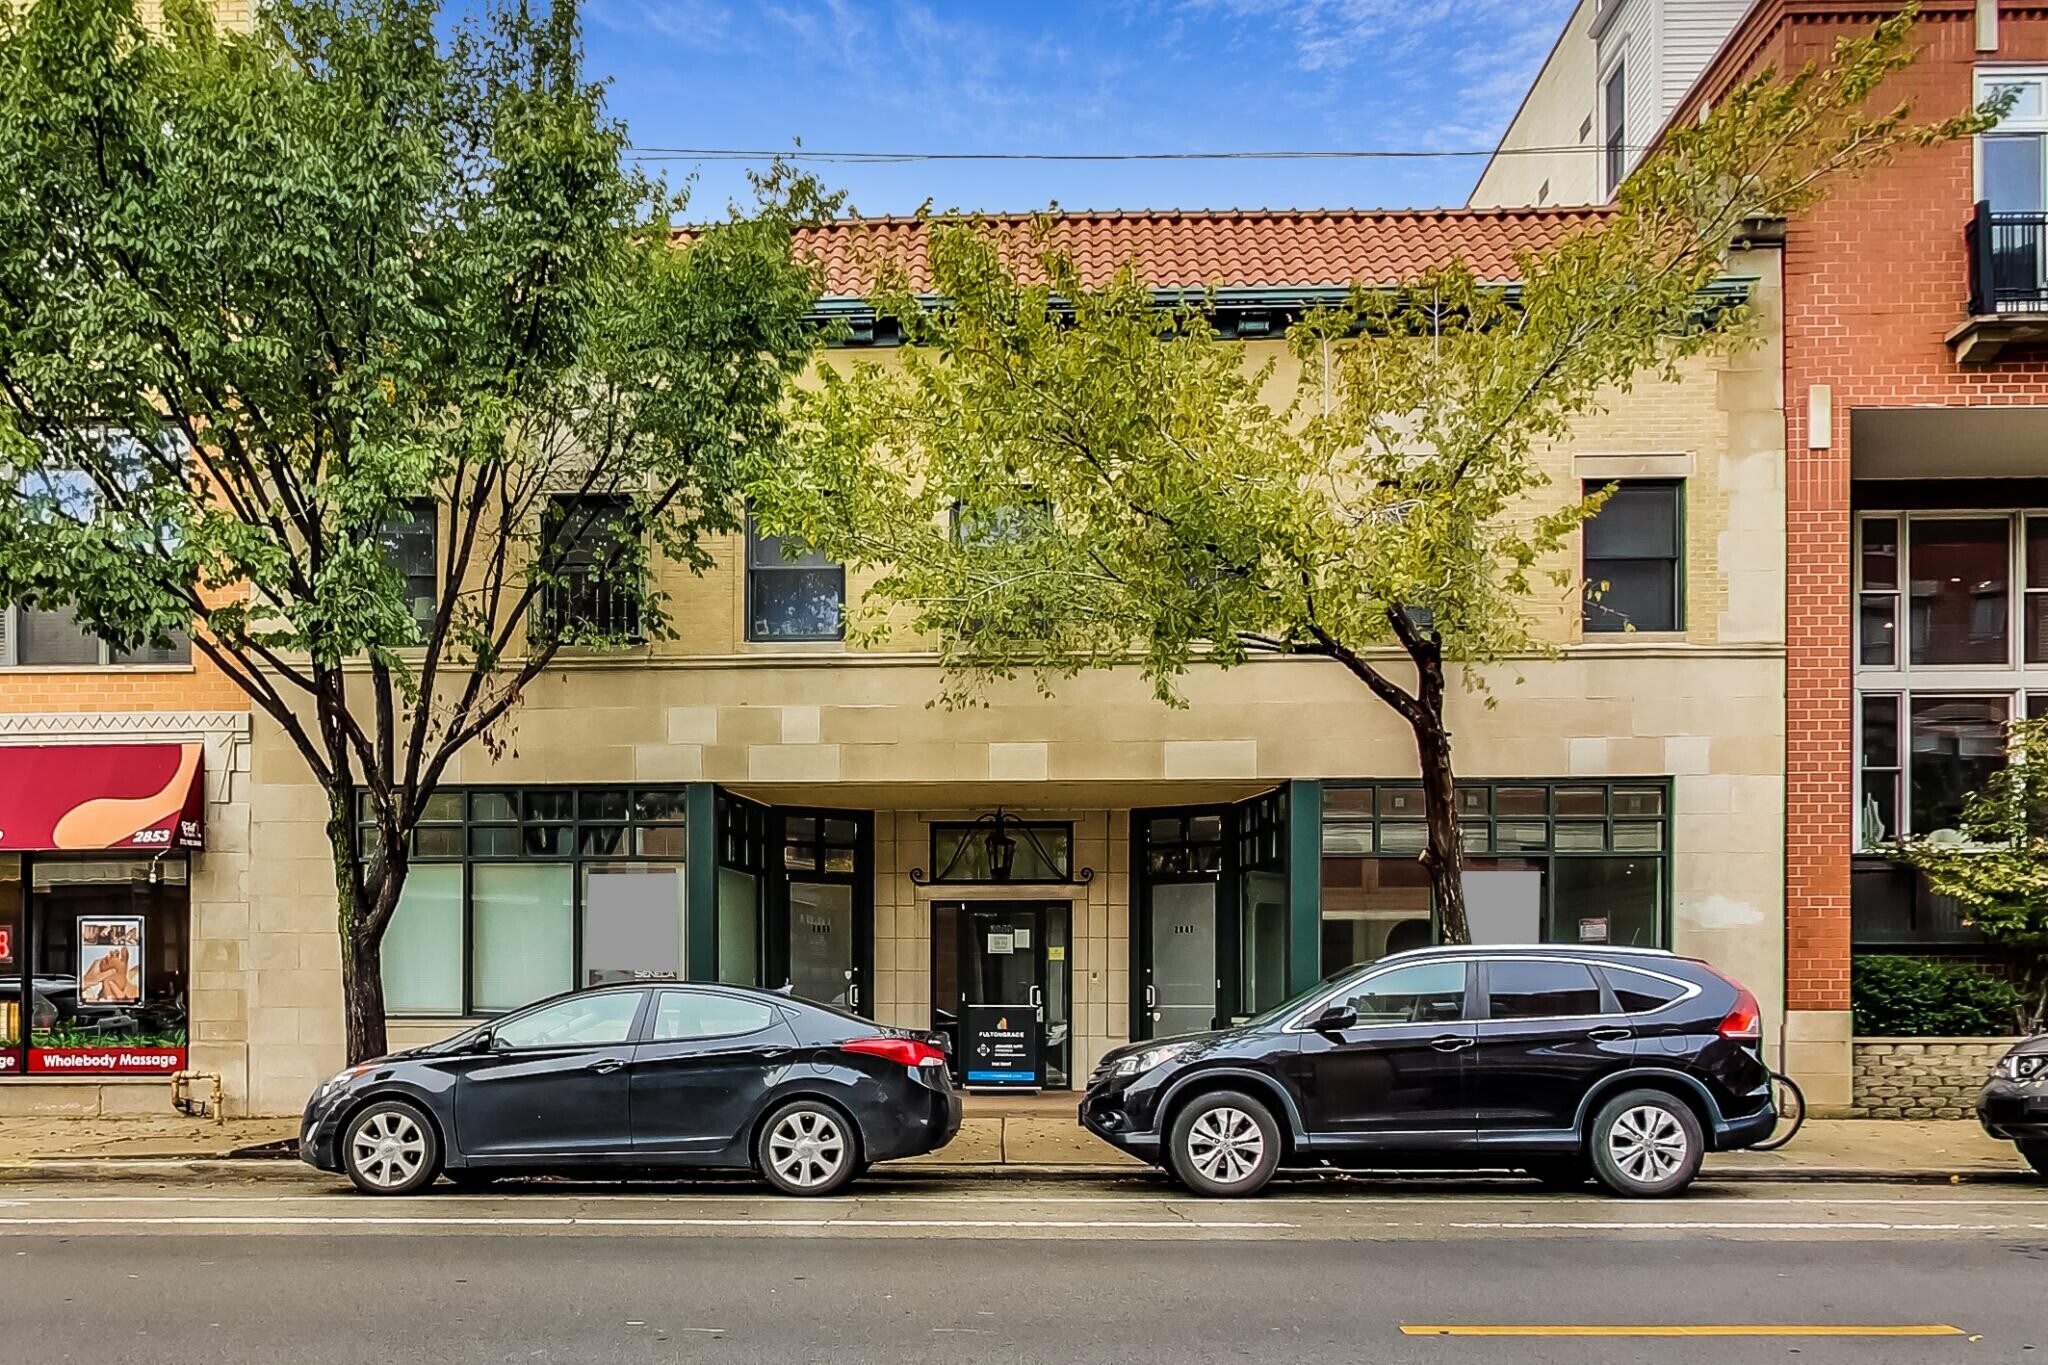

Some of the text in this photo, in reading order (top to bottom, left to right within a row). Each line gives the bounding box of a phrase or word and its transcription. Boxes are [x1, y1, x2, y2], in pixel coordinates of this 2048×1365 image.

[132, 830, 170, 843] 2853
[43, 1054, 178, 1068] Wholebody Massage
